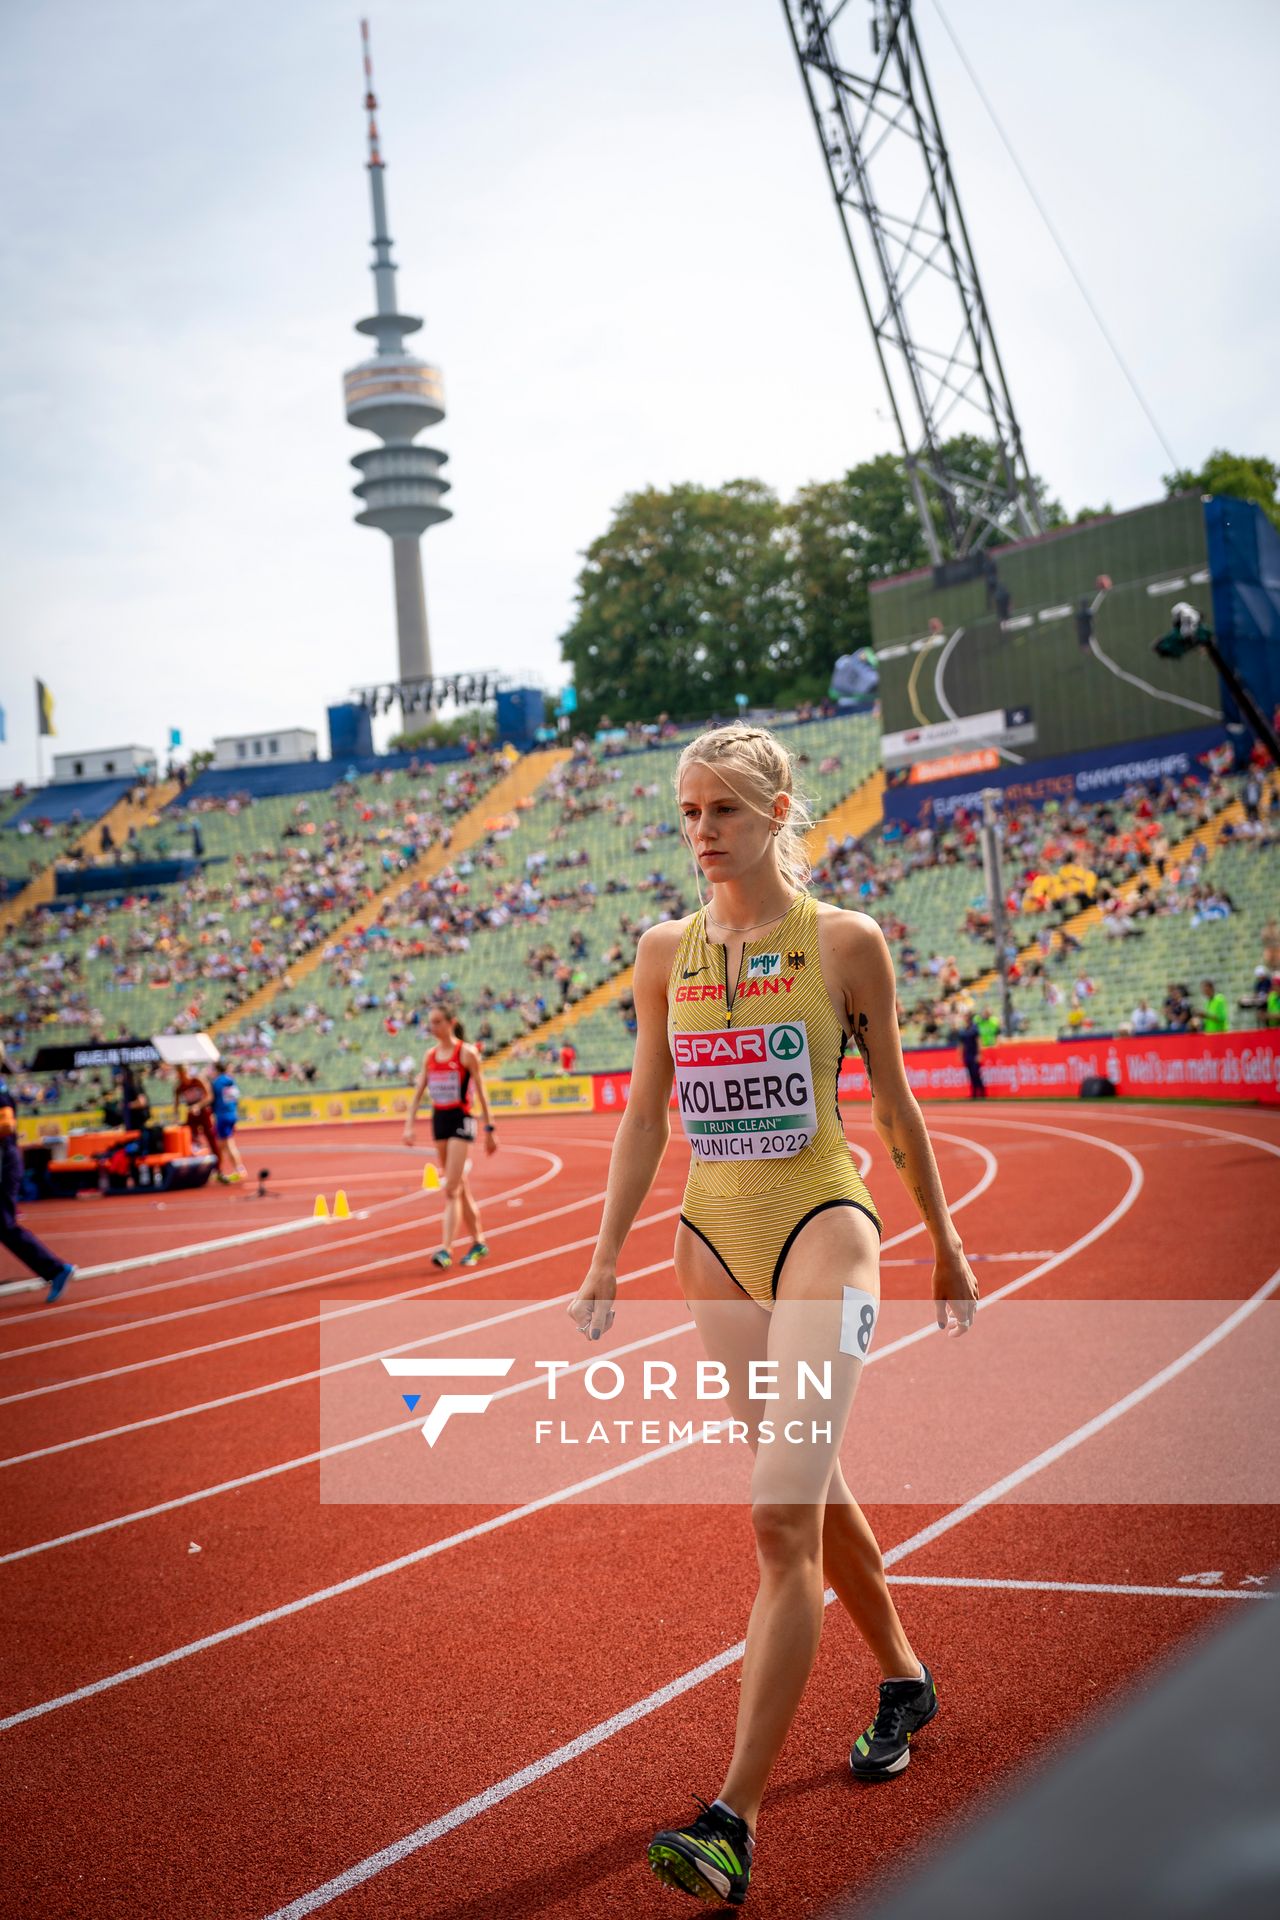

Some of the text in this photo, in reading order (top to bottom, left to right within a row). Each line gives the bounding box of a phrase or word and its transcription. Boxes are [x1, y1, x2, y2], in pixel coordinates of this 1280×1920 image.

[1075, 753, 1190, 790] CHAMPIONSHIPS
[676, 976, 795, 1003] GERMANY
[676, 1033, 764, 1063] SPAR
[1241, 1045, 1273, 1083] Geld
[680, 1073, 808, 1113] KOLBERG
[710, 1121, 735, 1133] RUN
[691, 1134, 808, 1156] MUNICH 2022
[857, 1304, 874, 1353] 8
